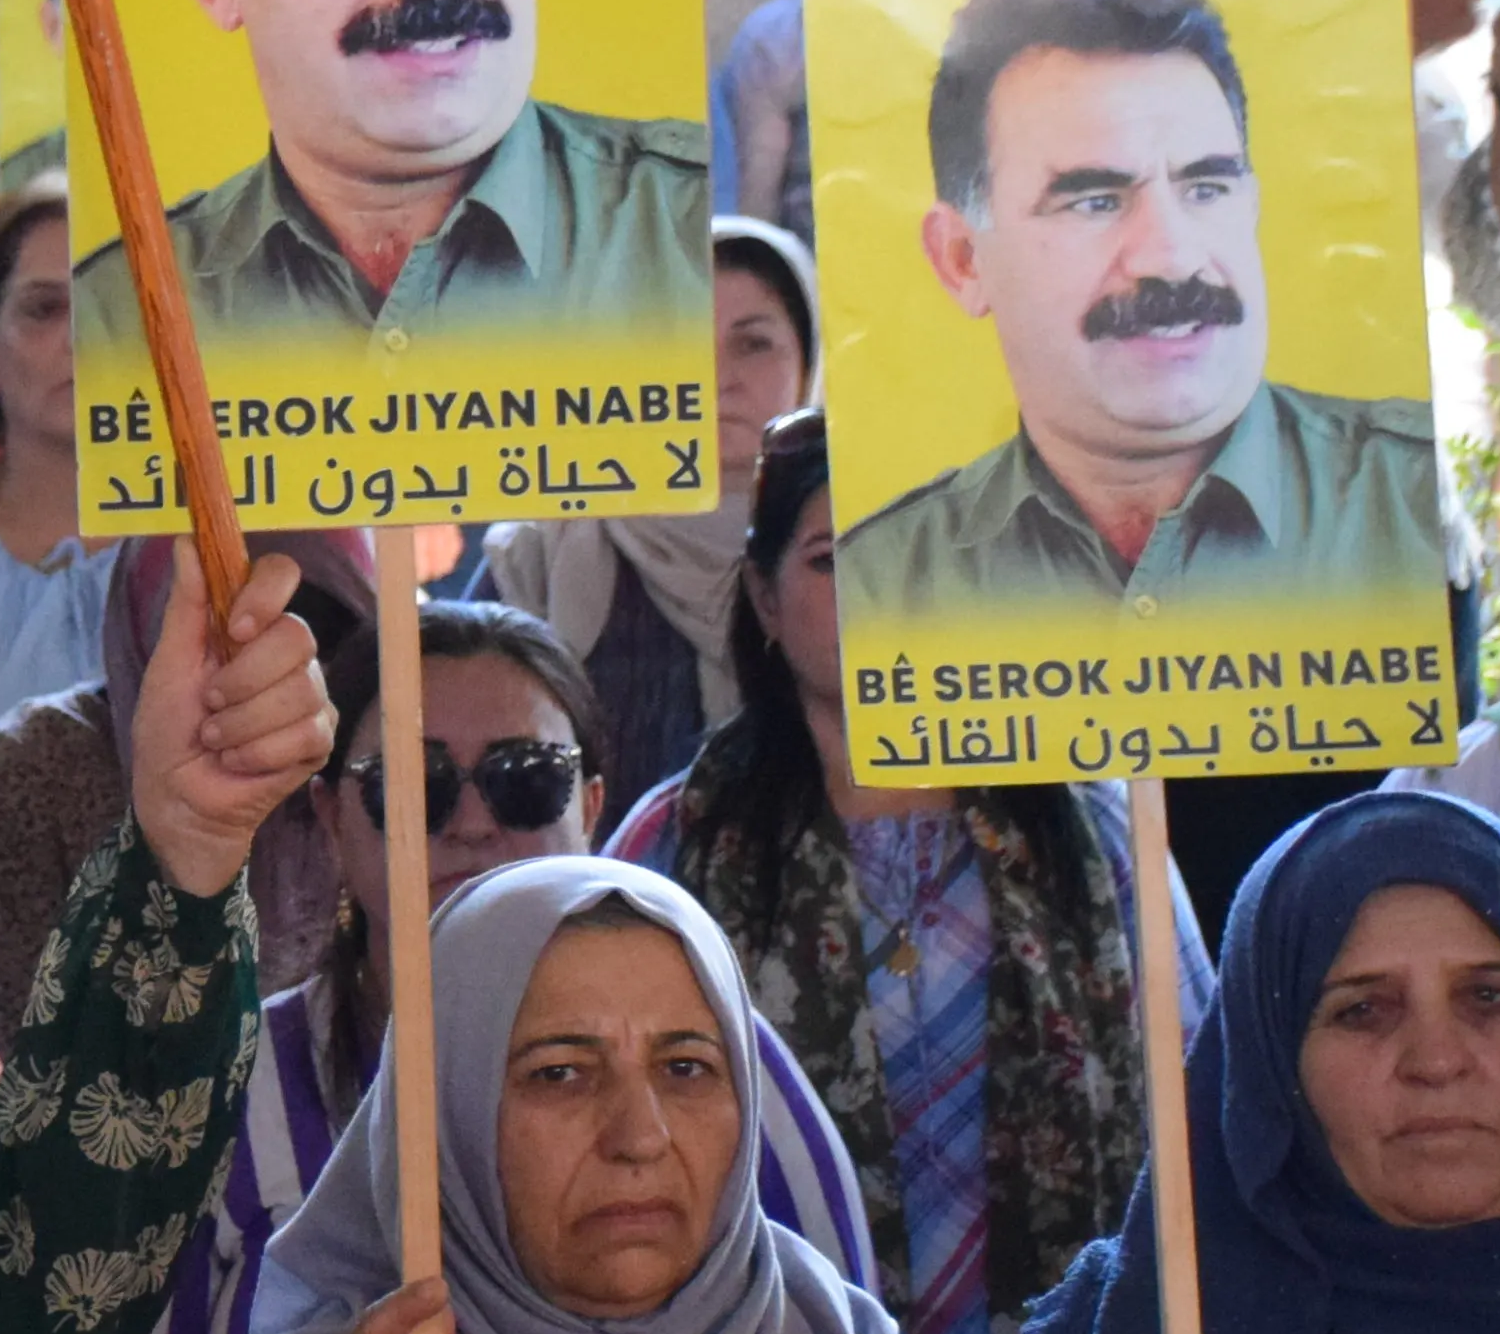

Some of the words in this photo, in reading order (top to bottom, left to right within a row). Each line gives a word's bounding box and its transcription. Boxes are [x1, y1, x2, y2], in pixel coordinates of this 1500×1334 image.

[89, 388, 153, 443] BÊ
[212, 395, 355, 436] EROK
[369, 389, 536, 434] JIYAN
[556, 383, 703, 427] NABE
[308, 458, 469, 517] بدون
[498, 443, 636, 512] حياة
[663, 439, 702, 489] لا
[857, 652, 917, 705] BÊ
[934, 658, 1110, 703] SEROK
[1124, 652, 1282, 695] JIYAN
[1301, 644, 1442, 688] NABE
[869, 713, 1038, 767] القائد
[1068, 717, 1221, 773] بدون
[1248, 703, 1382, 766] حياة
[1407, 698, 1444, 746] لا
